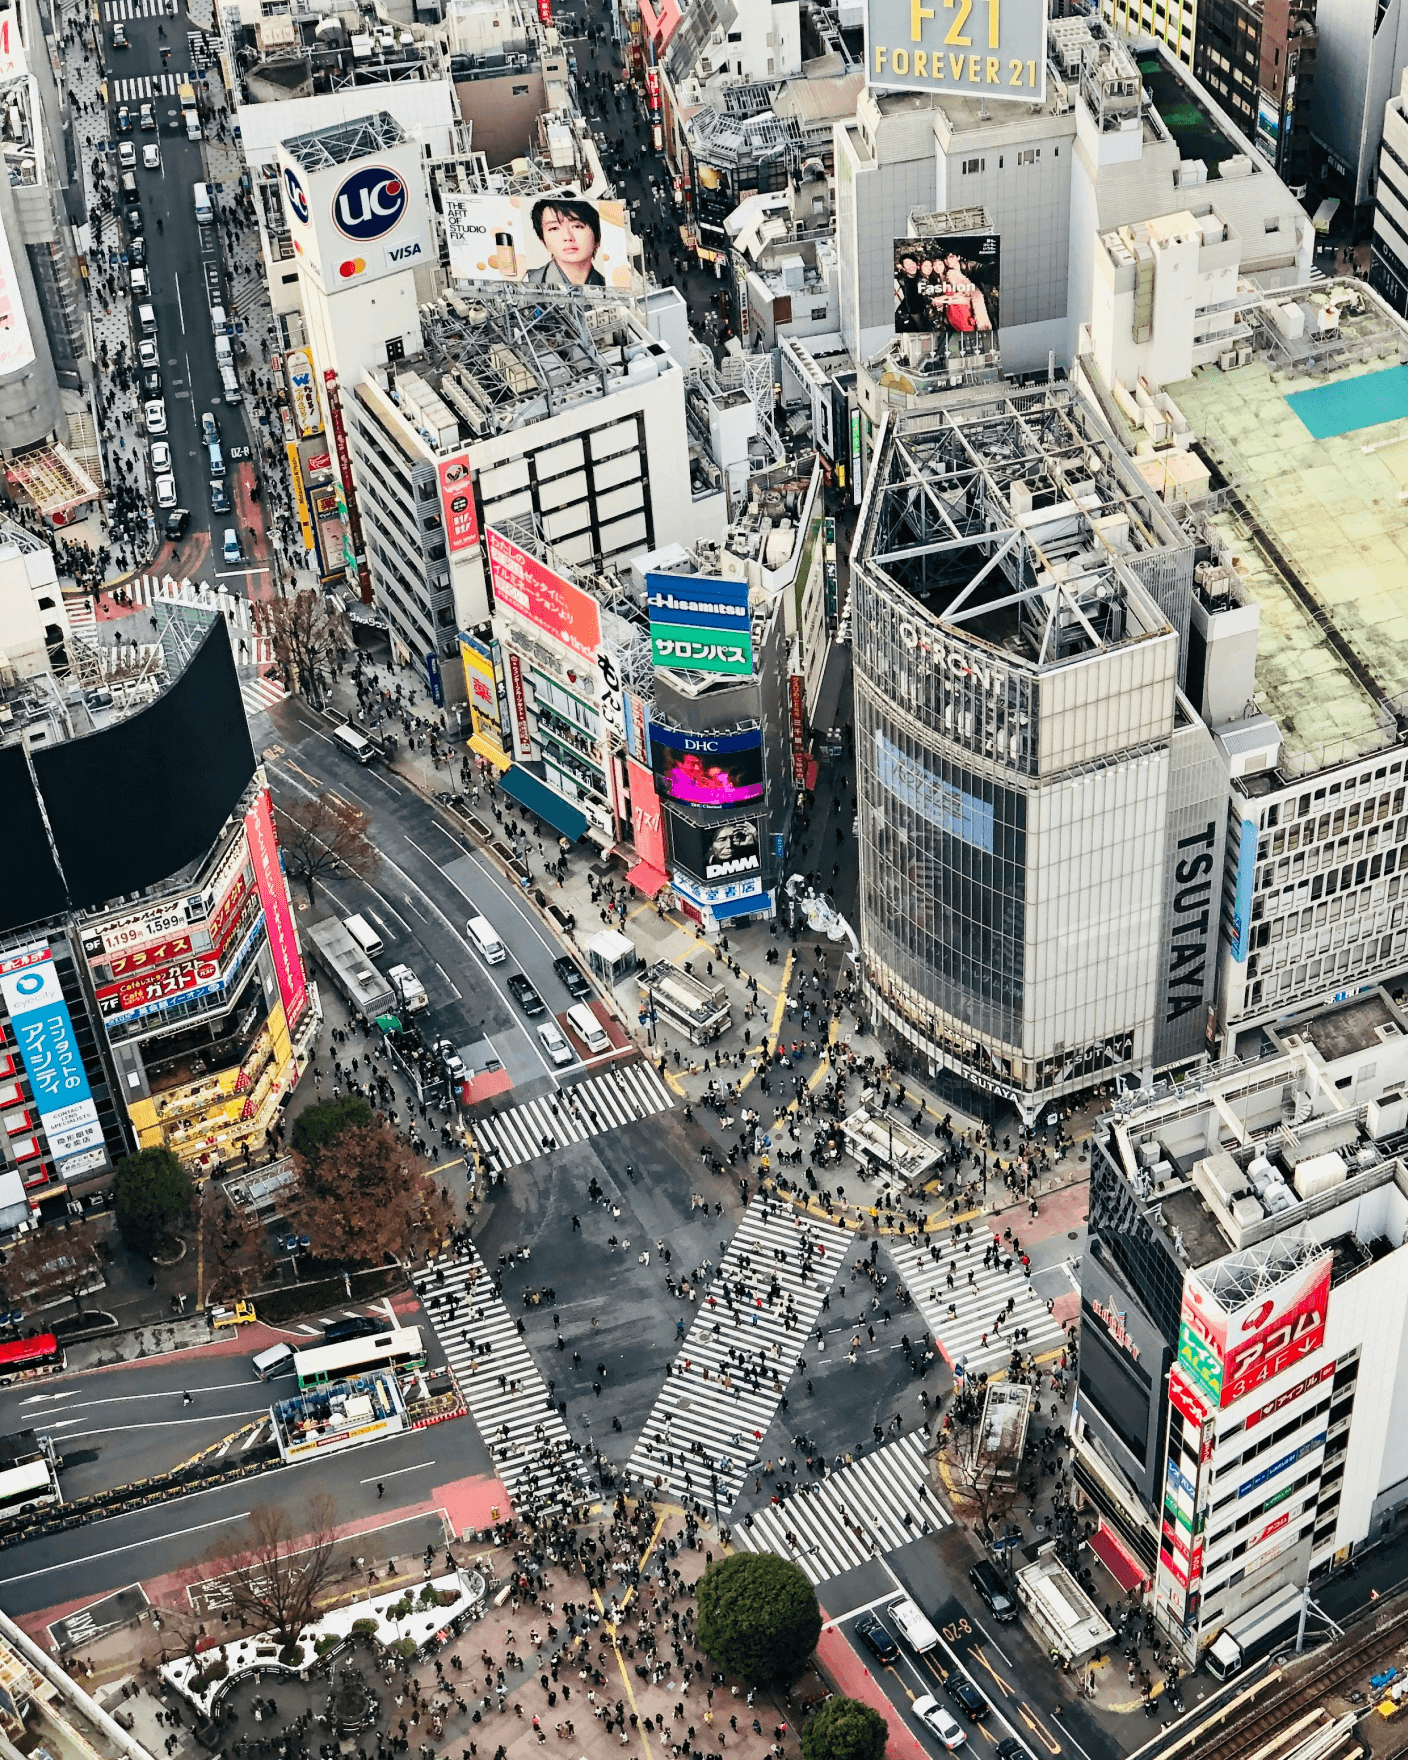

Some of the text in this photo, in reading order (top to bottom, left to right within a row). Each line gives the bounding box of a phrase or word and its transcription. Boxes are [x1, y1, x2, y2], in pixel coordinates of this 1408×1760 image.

[910, 0, 1000, 49] F21
[874, 45, 1037, 88] FOREVER 21
[447, 202, 467, 211] THE
[447, 209, 468, 218] ART
[448, 217, 462, 226] OF
[449, 224, 487, 234] STUDIO
[450, 232, 466, 241] FIX
[388, 242, 422, 262] VISA
[917, 281, 976, 294] Fashion
[655, 638, 746, 664] サロンパス
[684, 738, 719, 752] DHC
[705, 855, 760, 879] DMM
[1165, 820, 1217, 1025] TSUTAYA
[84, 938, 102, 952] 9F
[146, 974, 192, 999] ガスト
[13, 990, 55, 1009] eyecity
[100, 998, 119, 1012] 7F
[20, 1020, 61, 1094] アイシティ
[47, 1014, 81, 1089] コンタクトの
[1064, 1037, 1133, 1068] TSUTAYA
[962, 1069, 1020, 1103] TSUTAYA
[53, 1105, 83, 1119] CONTACT
[1183, 1326, 1222, 1375] レイク
[1233, 1309, 1321, 1380] アコム
[1277, 1374, 1318, 1407] アイフル
